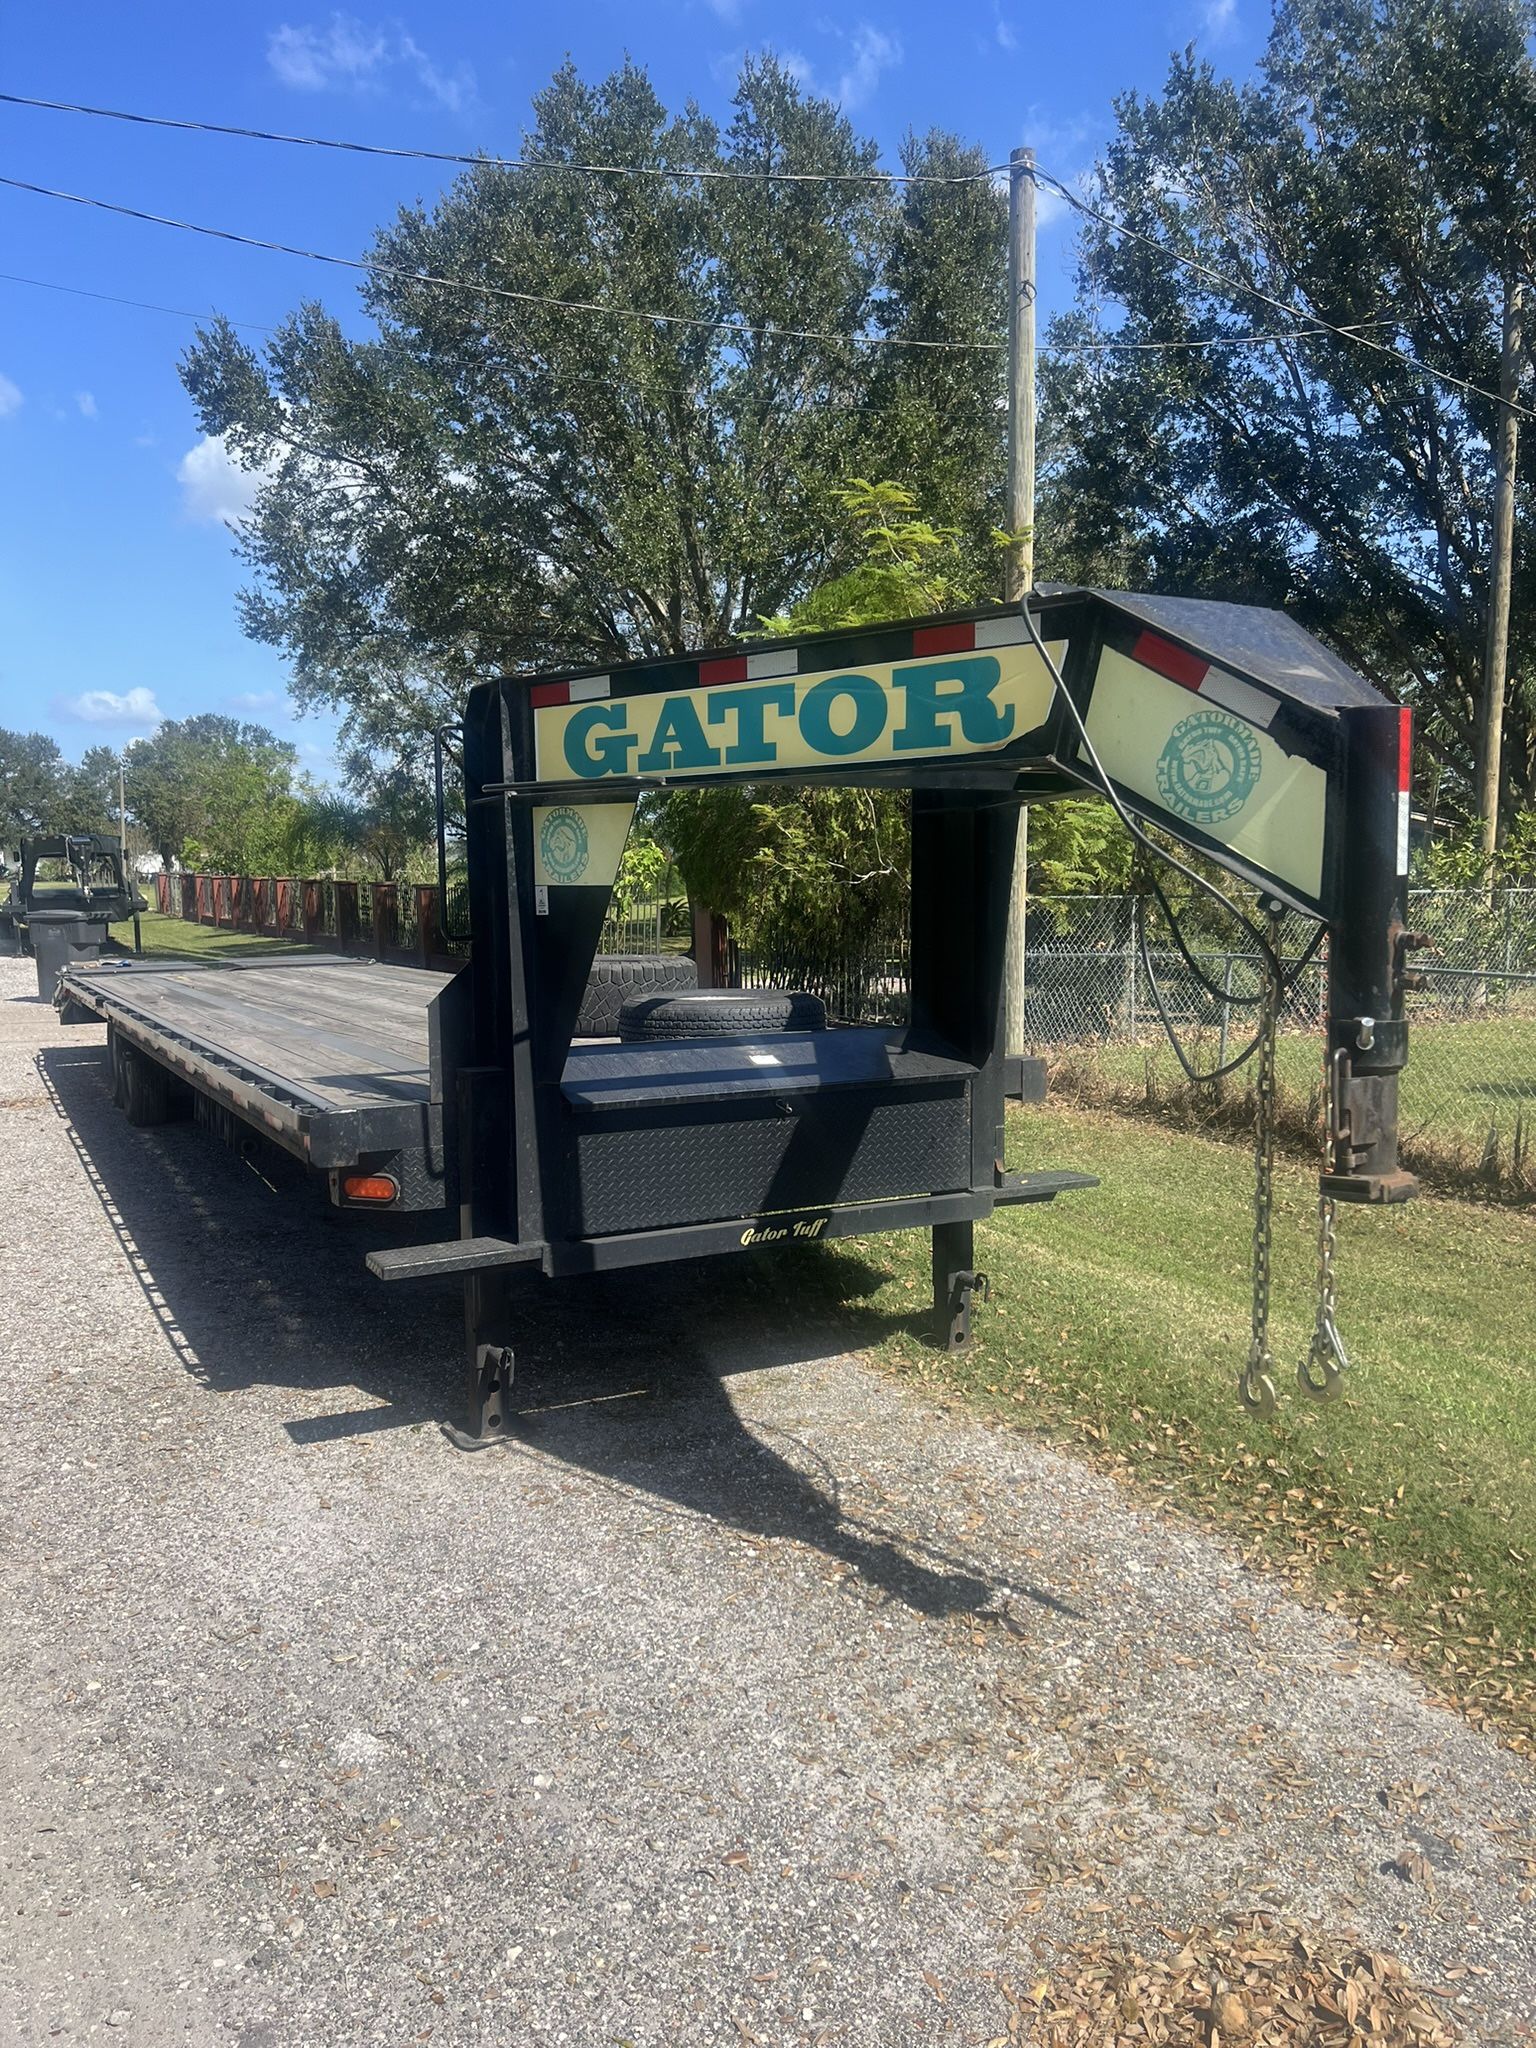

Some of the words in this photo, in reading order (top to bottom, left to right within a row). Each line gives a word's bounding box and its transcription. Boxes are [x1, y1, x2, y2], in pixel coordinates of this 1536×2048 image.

[564, 656, 1015, 778] GATOR
[1172, 711, 1262, 783] GATORMADE
[1157, 756, 1245, 824] TRAILERS
[542, 852, 589, 883] TRAILERS
[740, 1227, 788, 1246] Gator
[793, 1218, 828, 1238] Tuff
